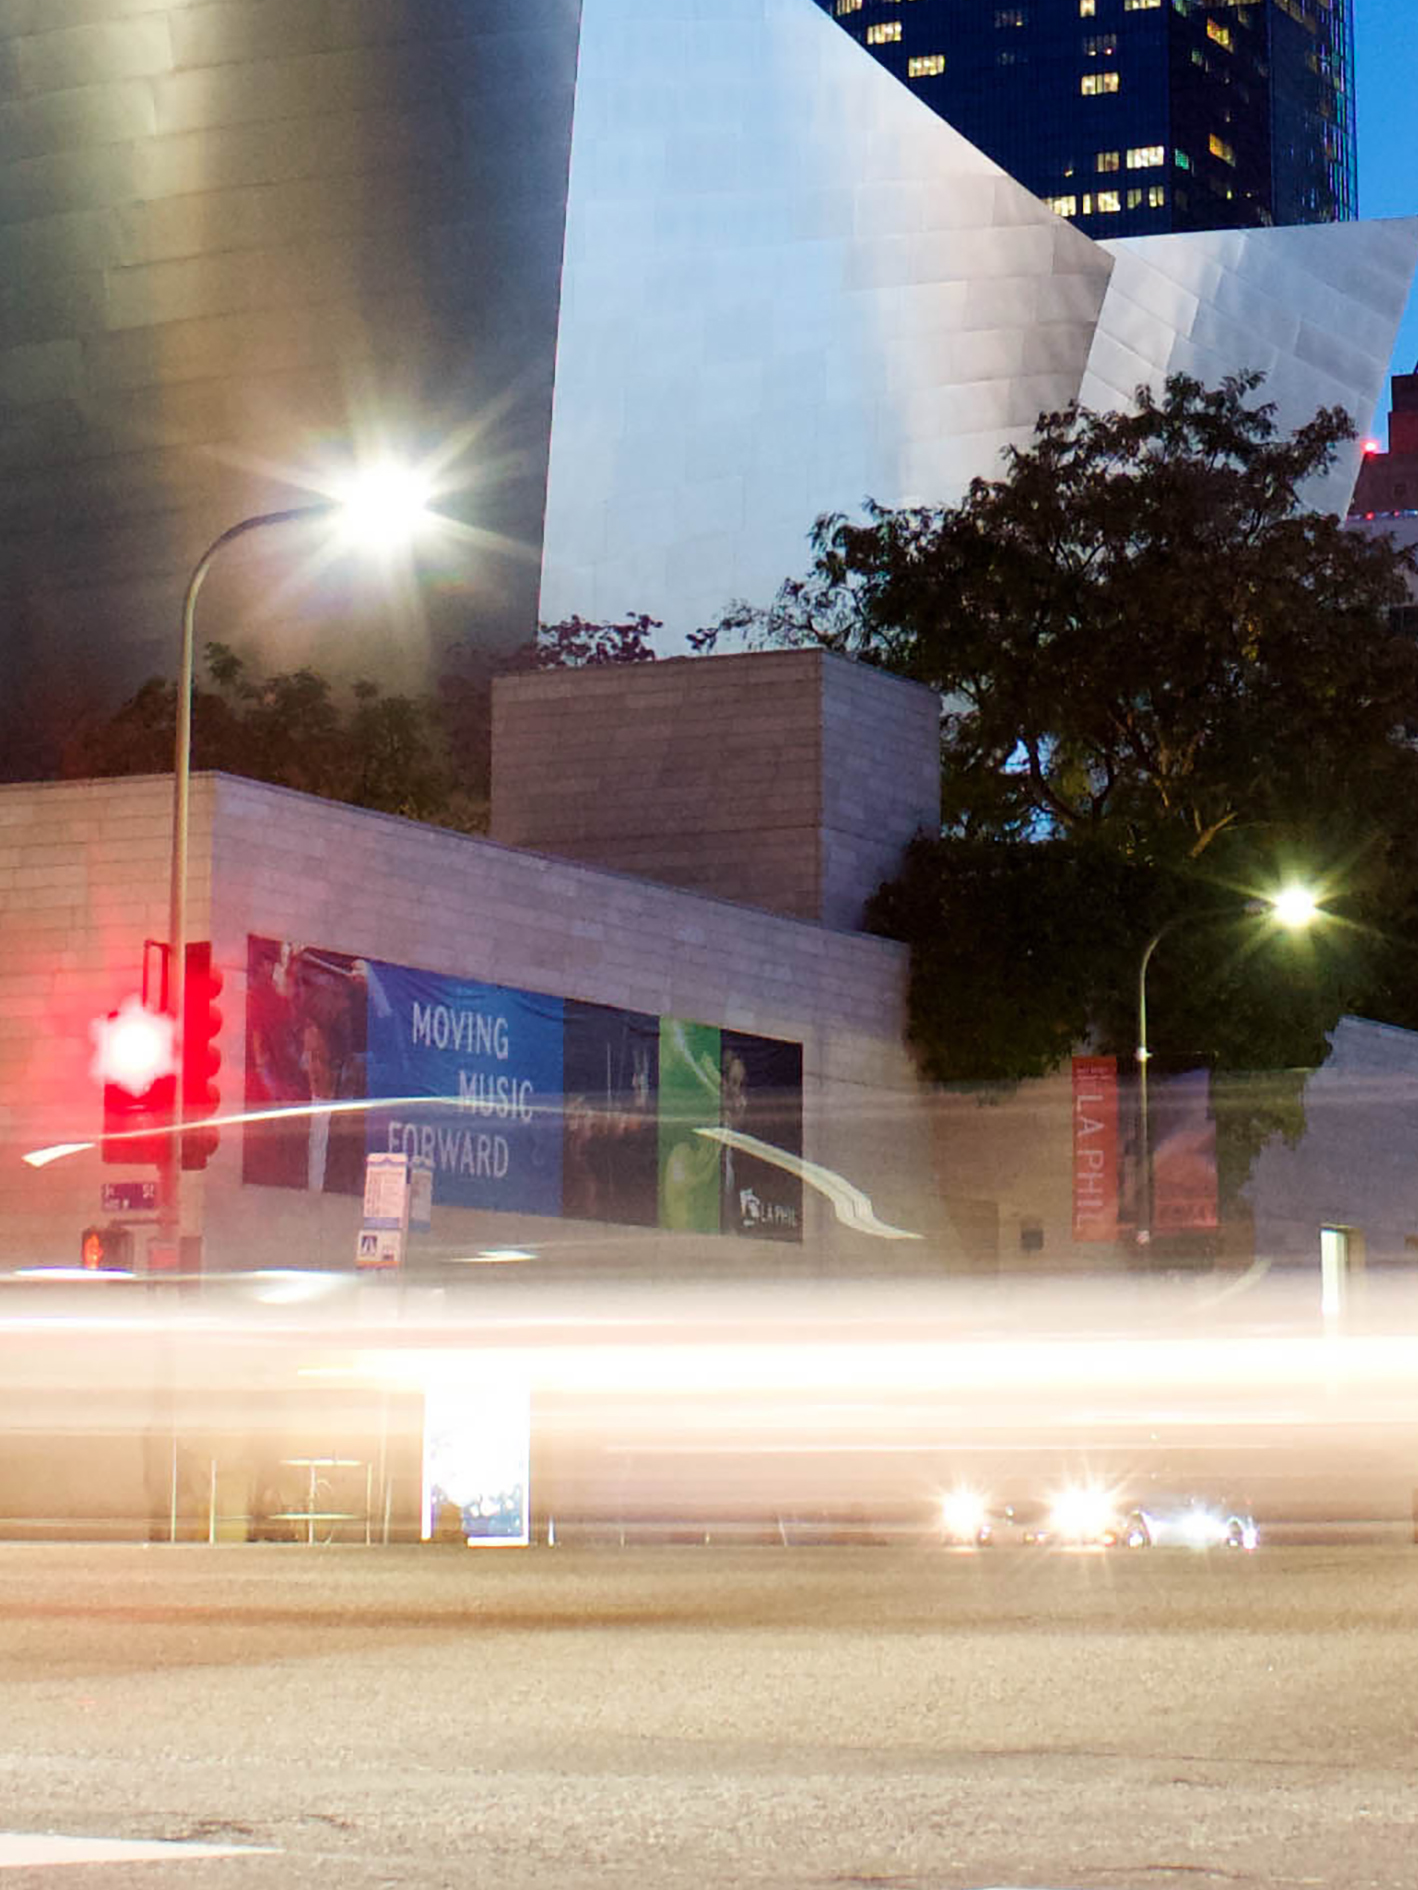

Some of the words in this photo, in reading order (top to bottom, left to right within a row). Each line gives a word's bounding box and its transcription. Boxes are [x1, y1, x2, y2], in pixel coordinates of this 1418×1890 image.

[412, 1000, 509, 1060] MOVING
[458, 1069, 534, 1124] MUSIC
[1076, 1094, 1105, 1137] LA
[388, 1121, 510, 1179] FORWARD
[1076, 1150, 1105, 1229] PHIL
